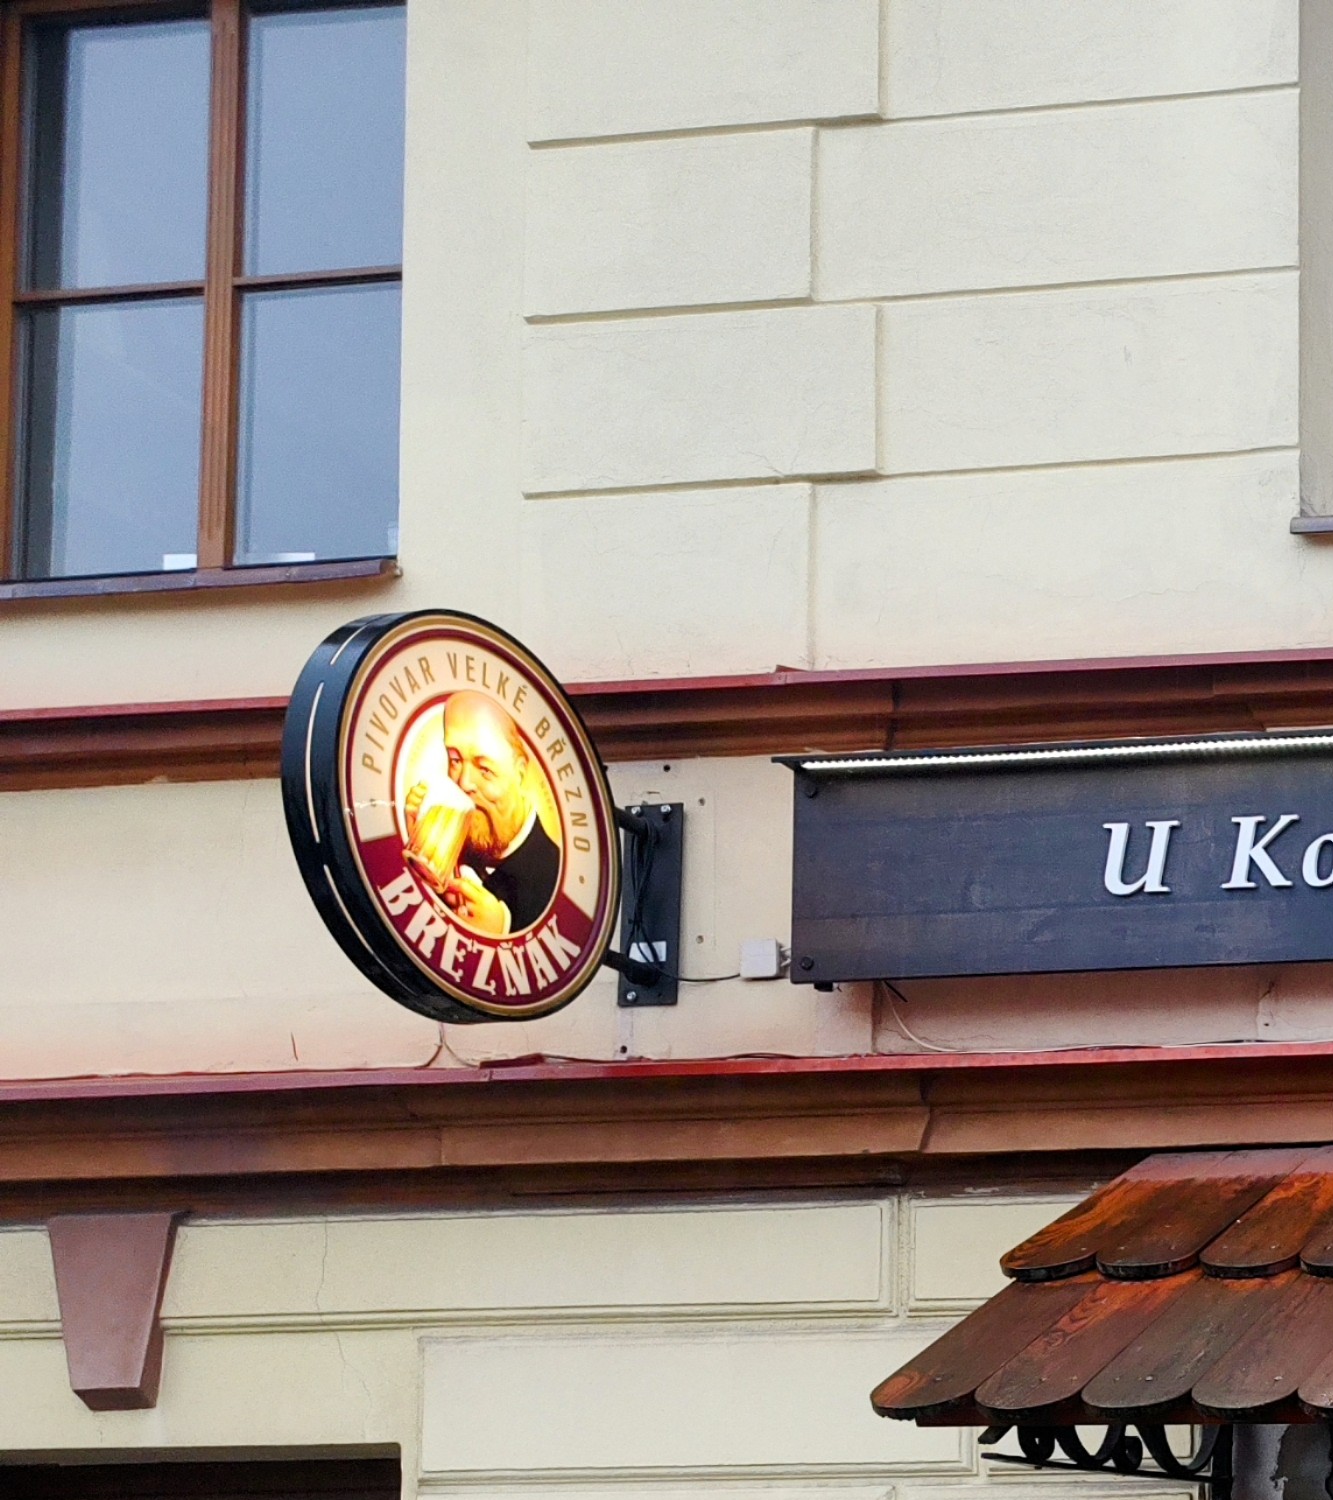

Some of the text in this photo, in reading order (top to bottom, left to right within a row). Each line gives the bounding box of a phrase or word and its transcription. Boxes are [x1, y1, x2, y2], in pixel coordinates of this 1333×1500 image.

[362, 652, 591, 853] PIVOVAR VELKÉ BŘEZNO
[1102, 819, 1181, 896] U
[378, 866, 581, 997] BŘEZŇÁK
